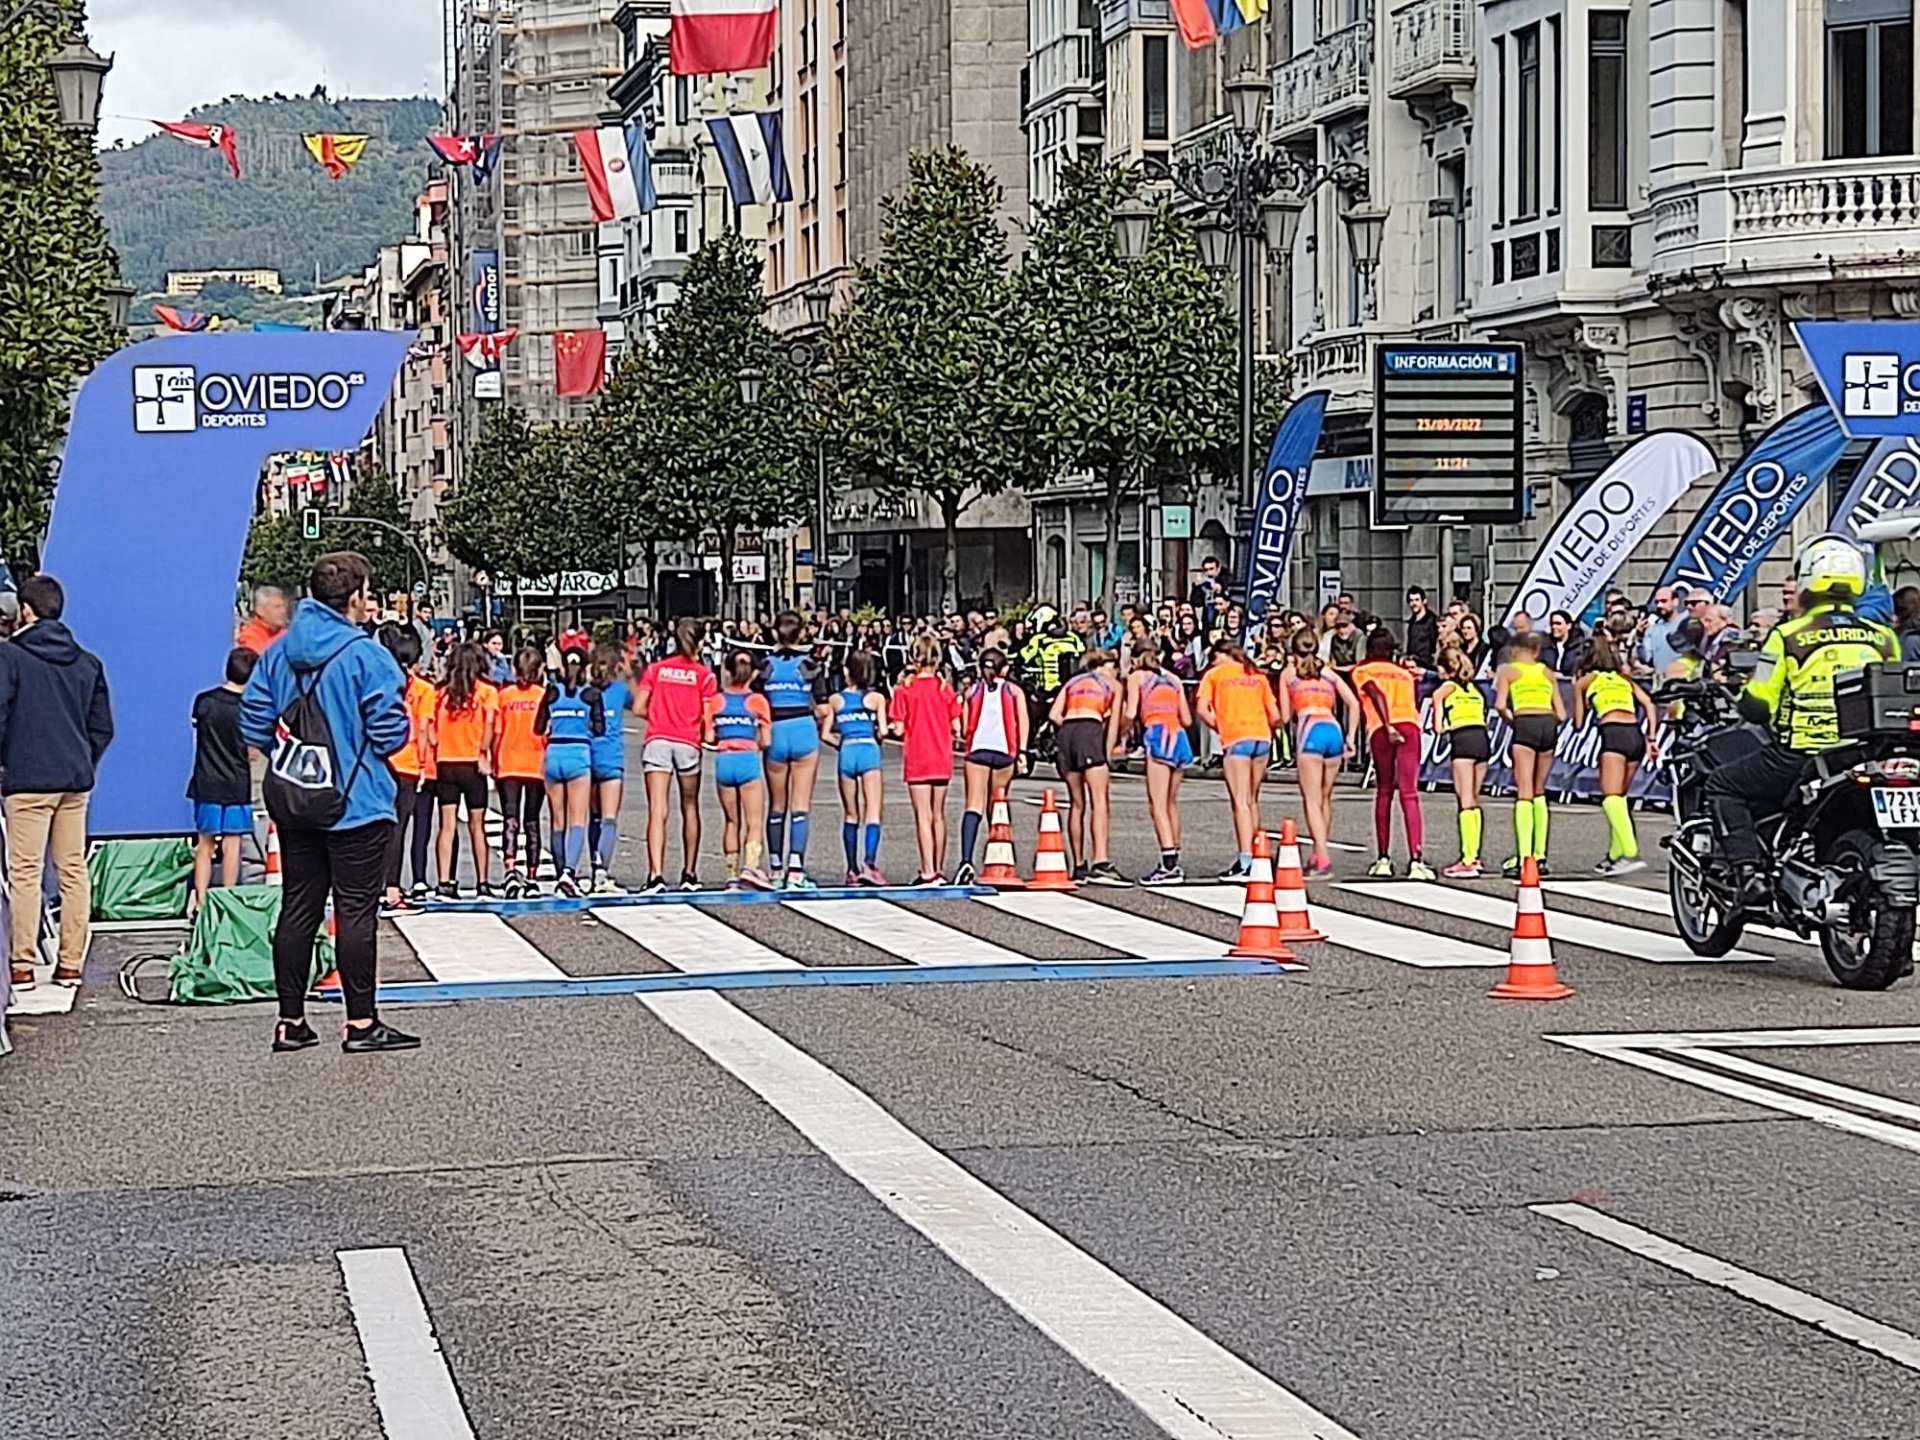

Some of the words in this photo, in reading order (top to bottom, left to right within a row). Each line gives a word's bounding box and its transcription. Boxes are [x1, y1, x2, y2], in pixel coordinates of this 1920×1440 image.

[484, 266, 498, 321] elecnor
[1394, 353, 1493, 369] INFORMACIÓN
[202, 413, 267, 427] DEPORTES
[1522, 480, 1634, 621] OVIEDO
[1593, 548, 1612, 568] DE
[1607, 499, 1656, 551] DEPORTES
[1713, 558, 1748, 600] EJALÍA
[1742, 537, 1762, 558] DE
[1756, 473, 1808, 540] DEPORTES
[1795, 628, 1886, 647] SEGURIDAD
[657, 666, 697, 682] MBA
